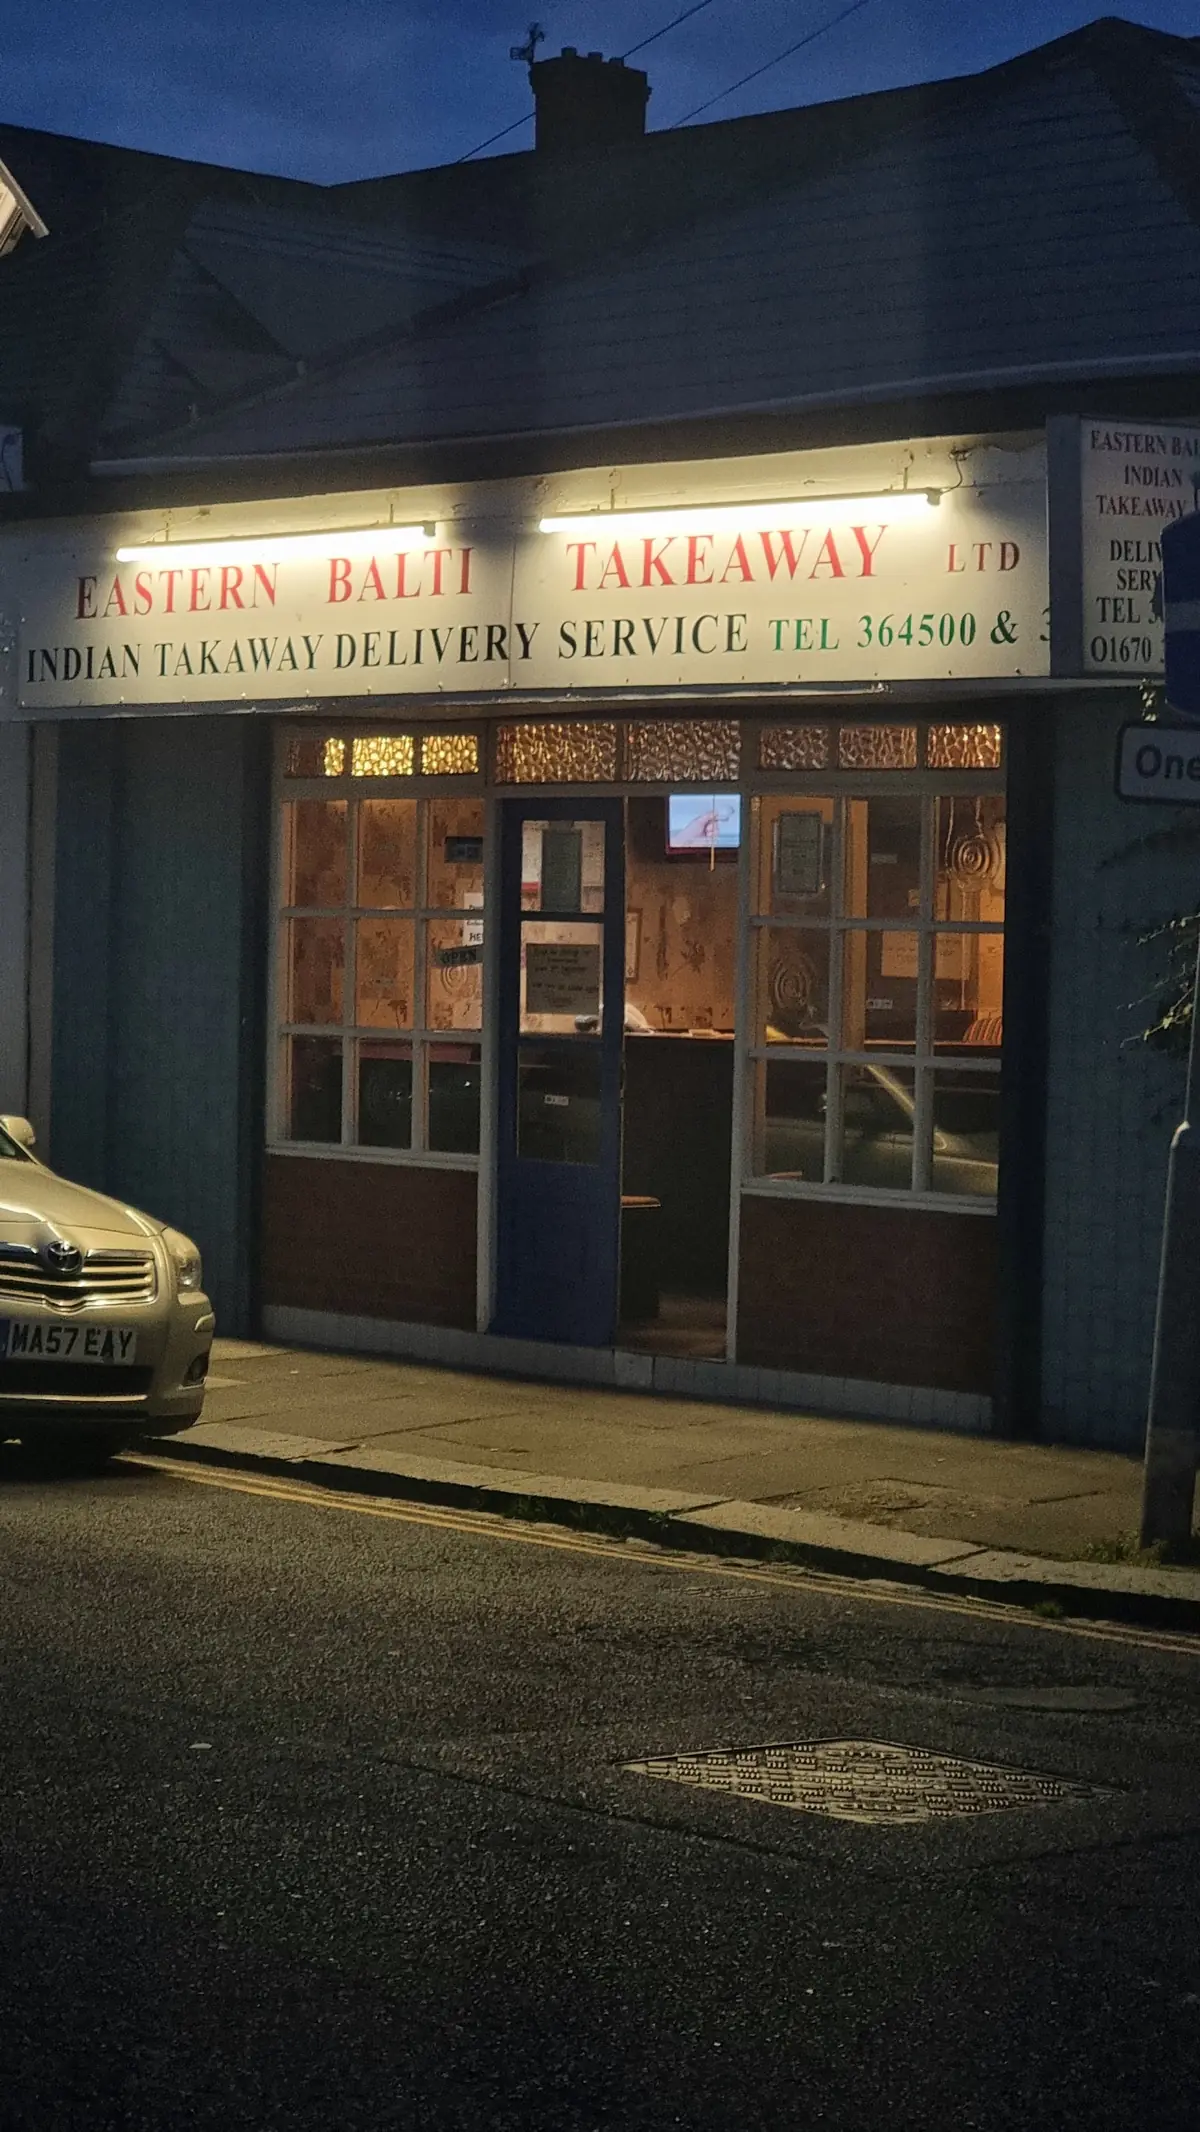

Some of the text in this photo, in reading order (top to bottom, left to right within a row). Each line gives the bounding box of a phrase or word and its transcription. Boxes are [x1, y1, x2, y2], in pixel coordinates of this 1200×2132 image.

[1091, 429, 1168, 456] EASTERN
[1123, 463, 1184, 488] INDIAN
[1095, 494, 1187, 519] TAKEAWAY
[74, 524, 1022, 621] EASTERN BALTI TAKEAWAY LTD
[1095, 596, 1141, 624] TEL
[26, 642, 142, 684] INDIAN
[154, 633, 325, 678] TAKAWAY
[333, 622, 541, 672] DELIVERY
[557, 612, 749, 660] SERVICE
[768, 617, 840, 652] TEL
[856, 611, 978, 649] 364500
[989, 609, 1020, 645] &
[1135, 743, 1200, 783] One
[439, 948, 478, 965] OPEN
[11, 1322, 79, 1356] MA57
